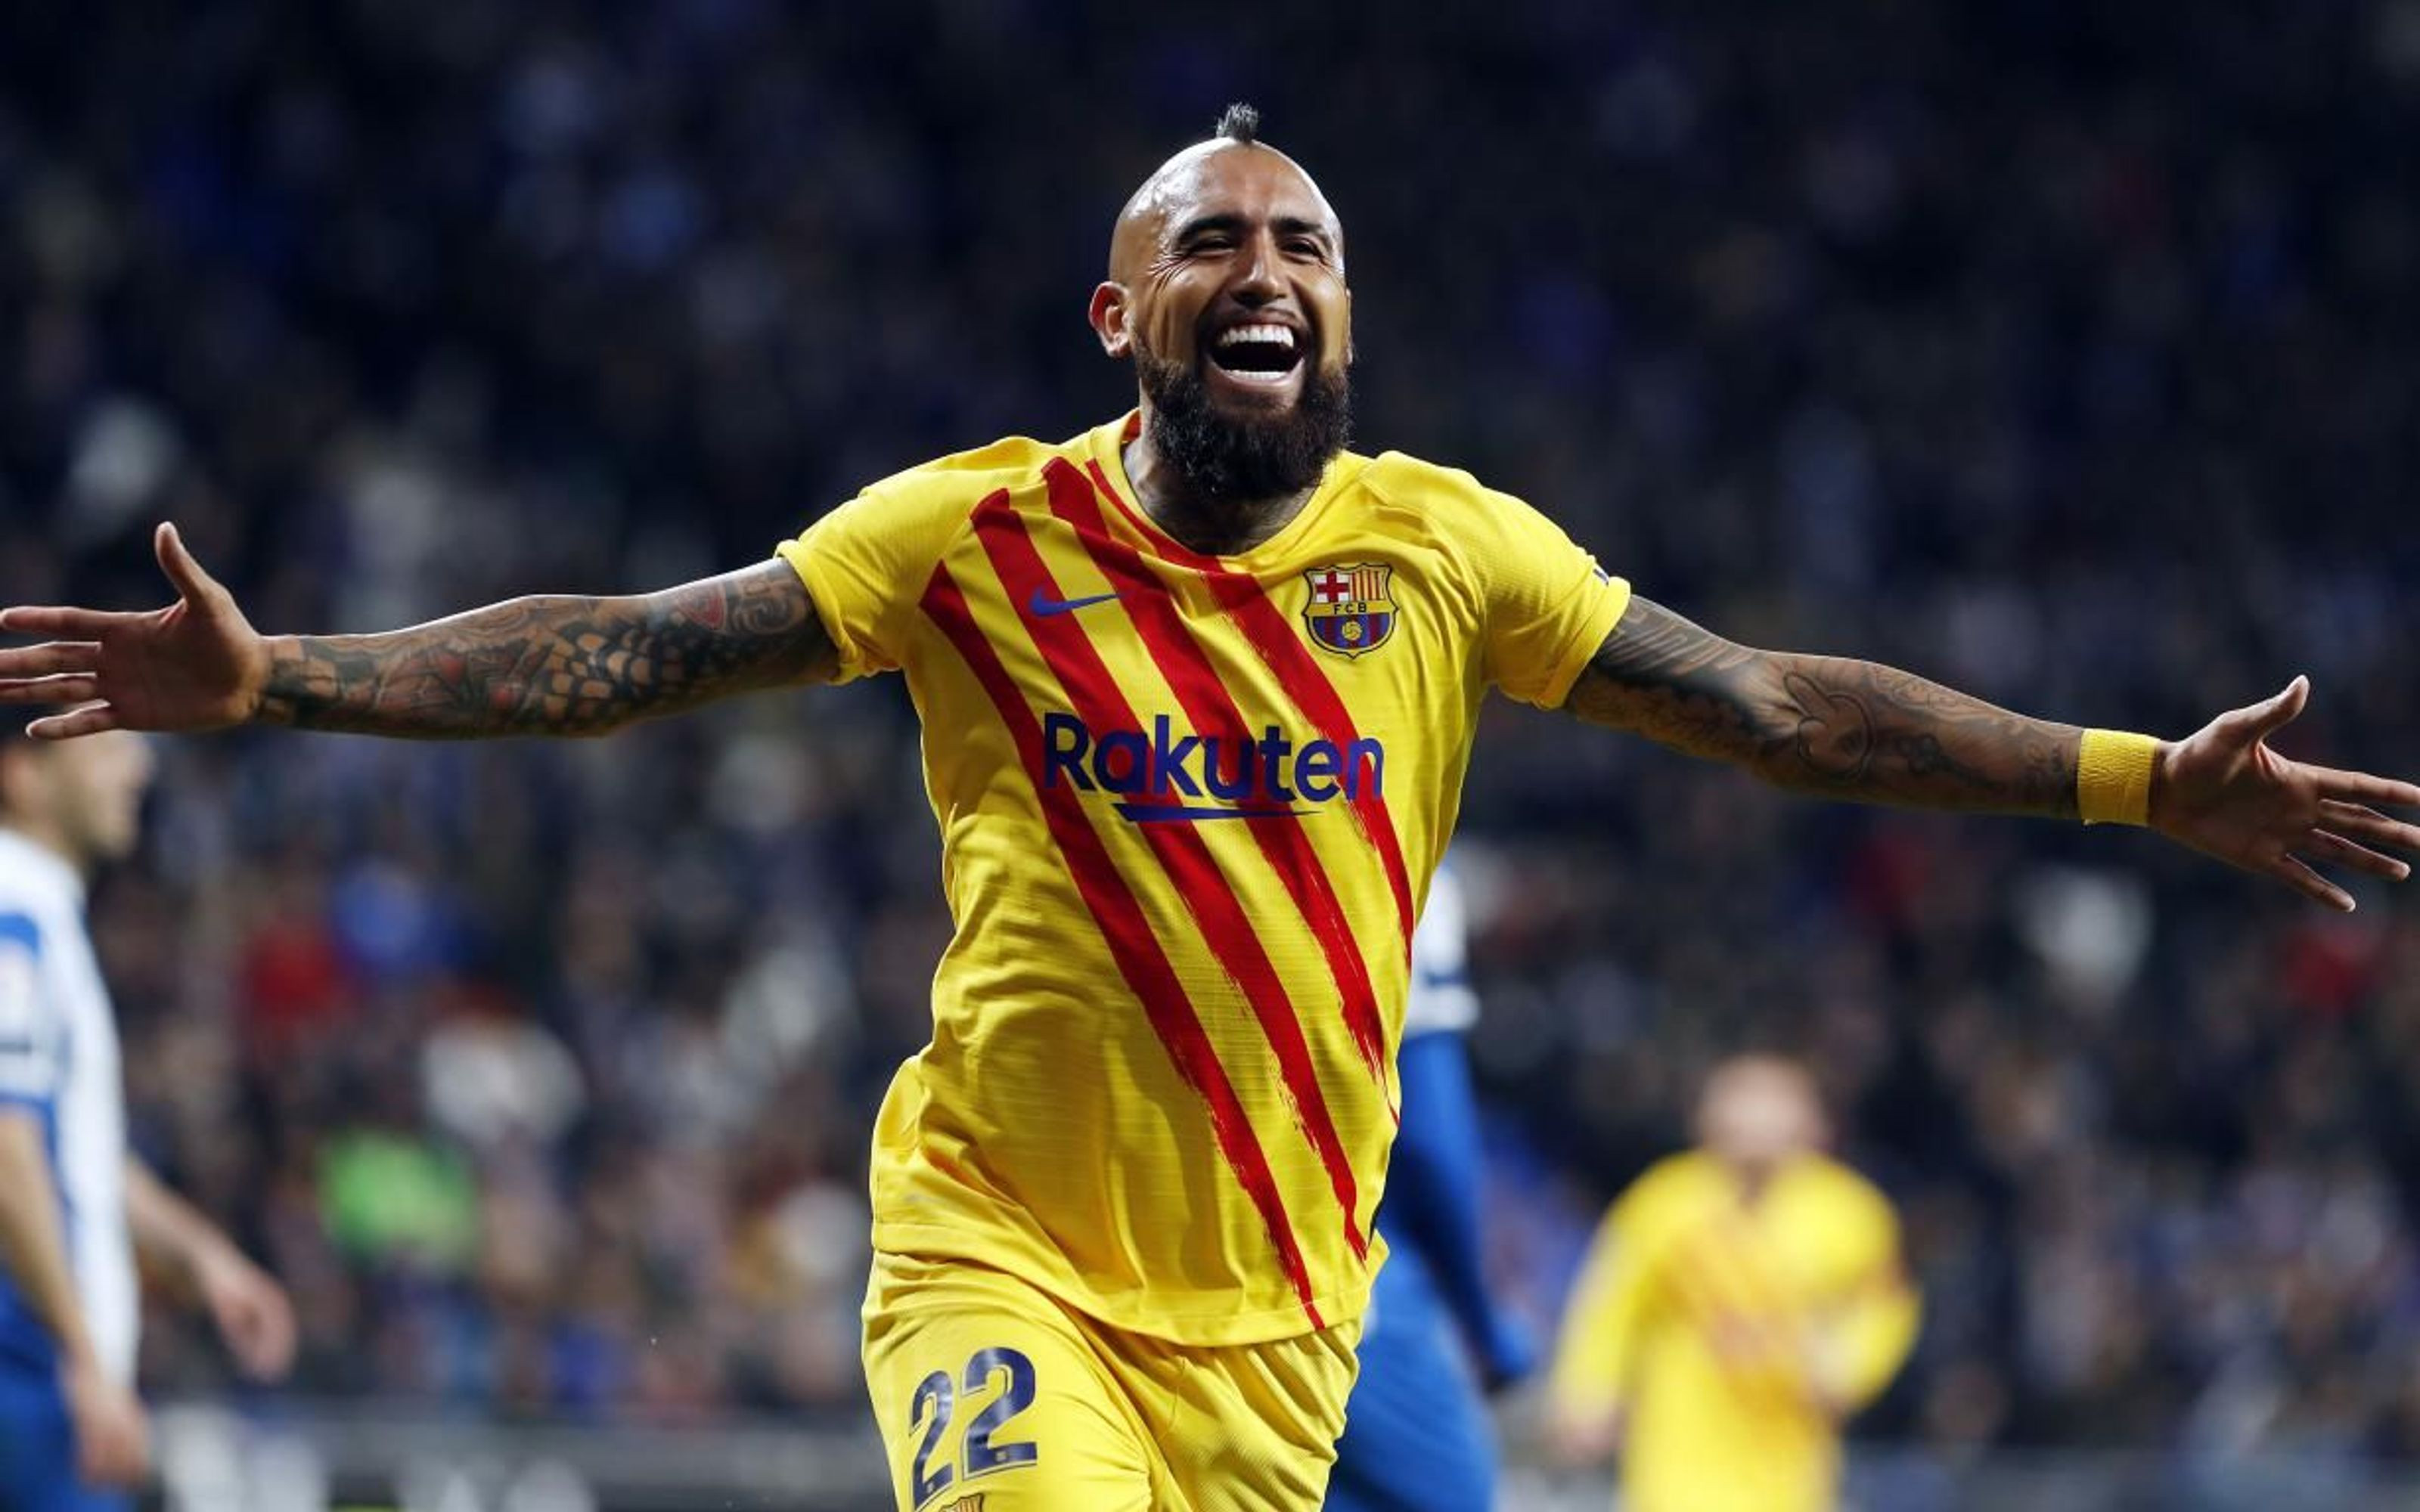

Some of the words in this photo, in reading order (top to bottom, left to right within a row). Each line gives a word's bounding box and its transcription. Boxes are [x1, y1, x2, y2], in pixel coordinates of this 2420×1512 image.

[1334, 603, 1367, 615] FCB
[1044, 712, 1384, 803] Rakuten
[909, 1347, 1037, 1511] 22
